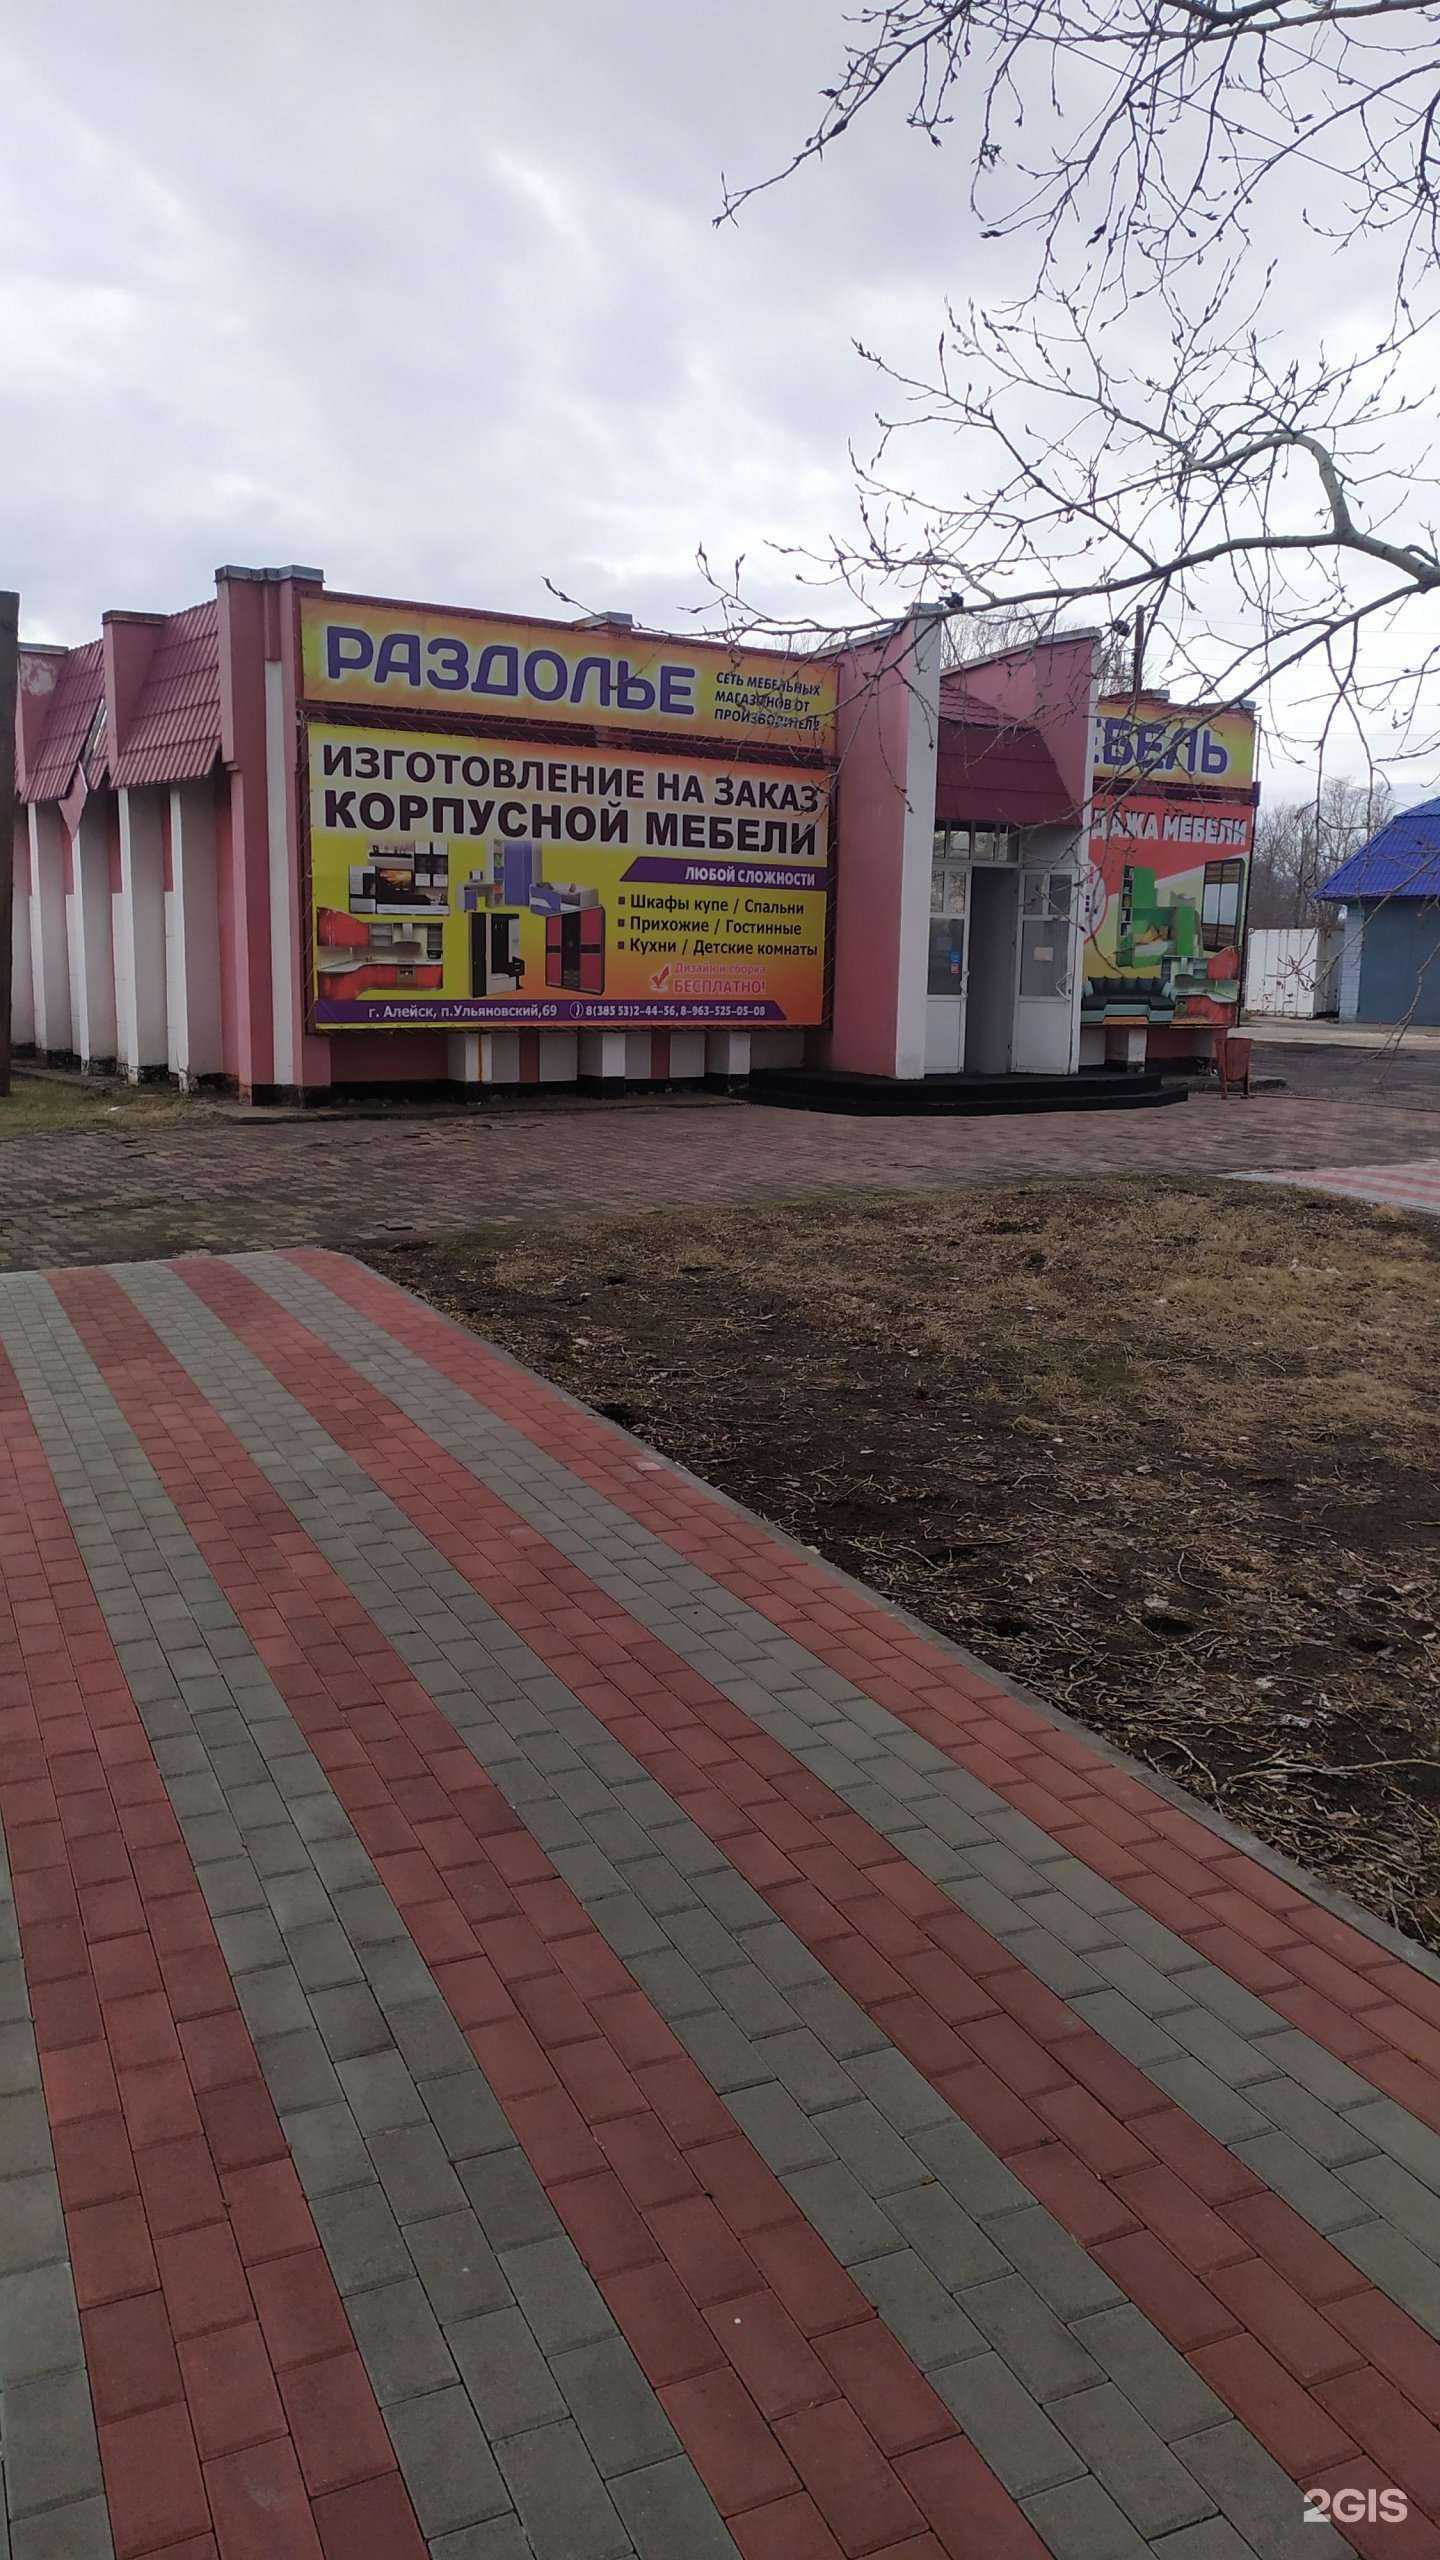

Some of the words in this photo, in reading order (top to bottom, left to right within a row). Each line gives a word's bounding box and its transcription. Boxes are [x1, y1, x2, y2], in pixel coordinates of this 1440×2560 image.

[326, 625, 695, 716] РАЗДОЛЬЕ
[716, 671, 744, 686] СЕТЬ
[747, 676, 821, 696] МЕБЕЛЬНЫХ
[794, 698, 810, 712] ОТ
[323, 744, 645, 799] ИЗГОТОВЛЕНИЕ
[657, 772, 704, 804] НА
[714, 777, 819, 813] ЗАКАЗ
[324, 789, 629, 844] КОРПУСНОЙ
[645, 811, 817, 855] МЕБЕЛИ
[1162, 811, 1248, 846] МЕБЕЛИ
[685, 865, 735, 882] ЛЮБОЙ
[738, 872, 816, 887] СЛОЖНОСТИ
[630, 894, 690, 913] Шкафы
[694, 898, 729, 914] купе
[744, 899, 805, 915] Спальни
[630, 916, 710, 932] Прихожие
[726, 919, 802, 936] Гостинные
[629, 938, 677, 955] Кухни
[693, 940, 754, 956] Детские
[757, 943, 818, 957] комнаты
[675, 963, 716, 975] Дизайн
[730, 962, 767, 977] сборка
[674, 980, 767, 994] БЕСПЛАТНО!
[368, 1008, 380, 1018] г.
[383, 1004, 437, 1019] Алейск,
